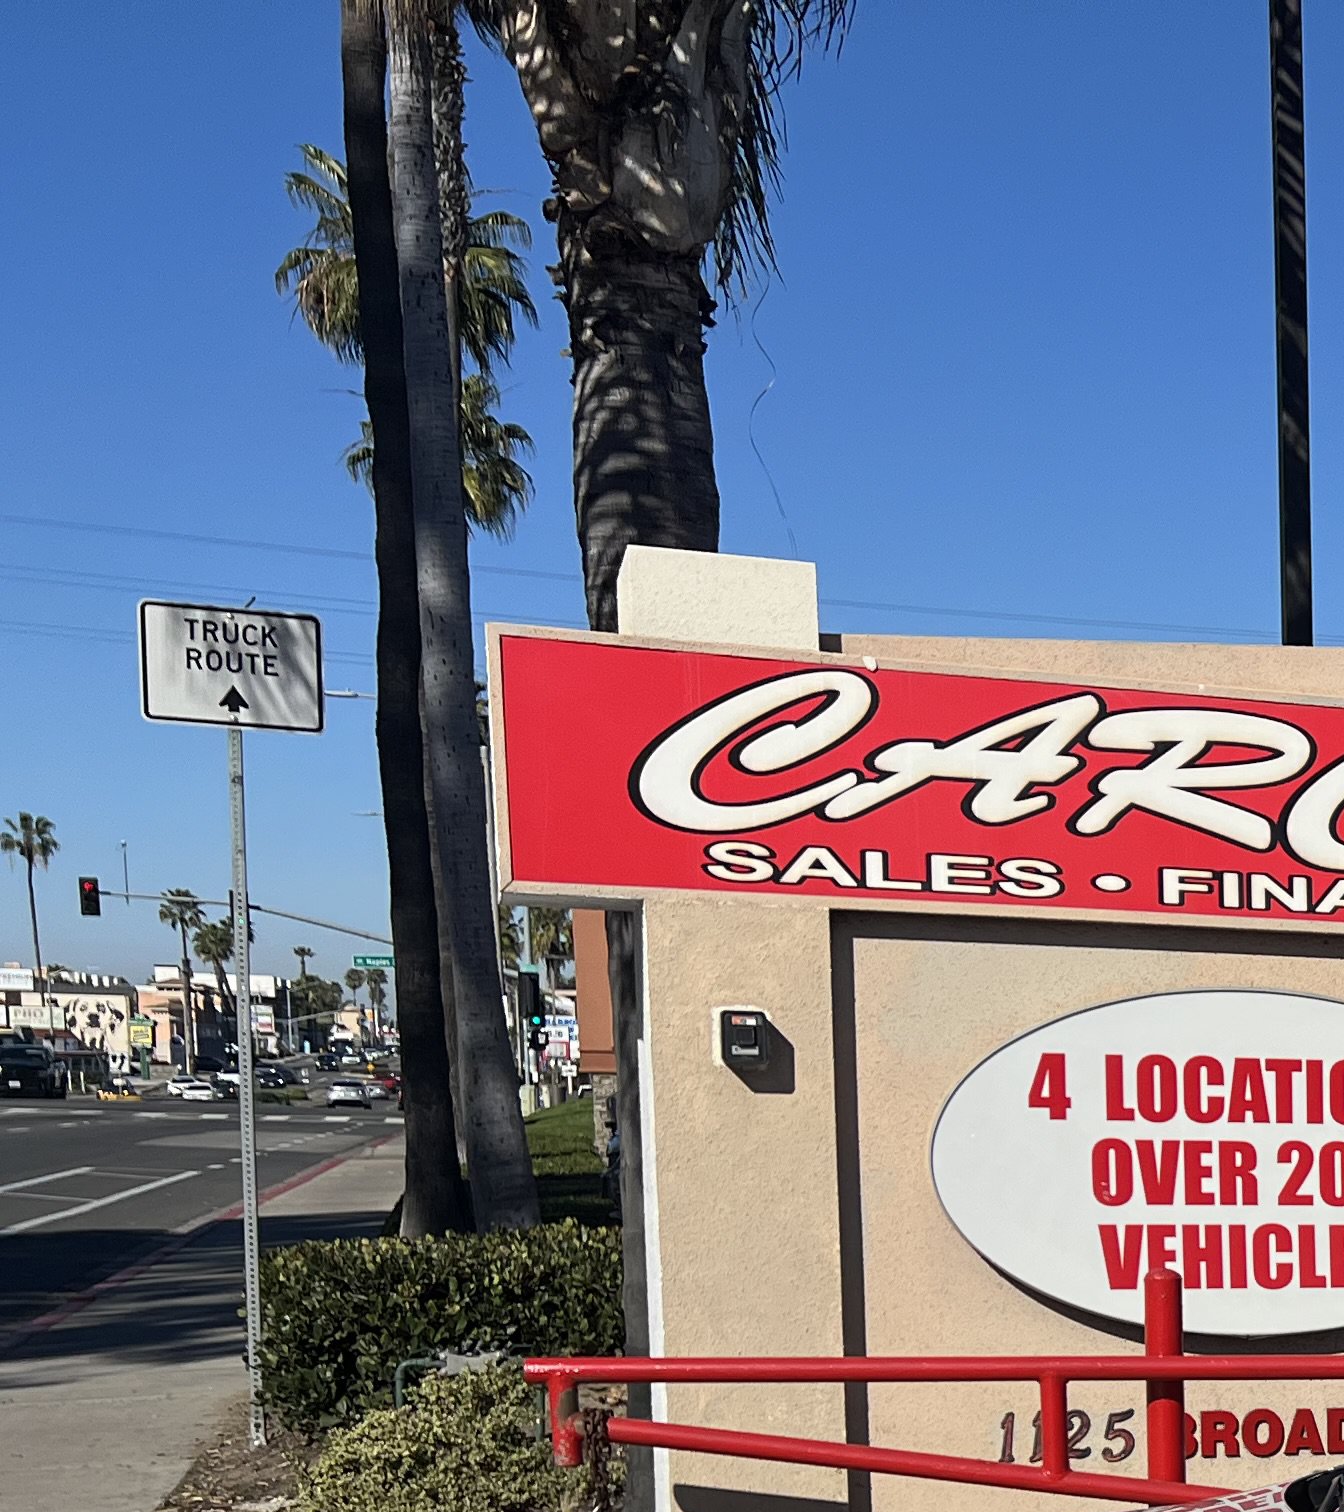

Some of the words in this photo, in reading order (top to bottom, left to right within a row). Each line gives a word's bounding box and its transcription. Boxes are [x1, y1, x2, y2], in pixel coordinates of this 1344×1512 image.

[184, 617, 279, 649] TRUCK
[185, 647, 280, 677] ROUTE
[701, 839, 1066, 898] SALES
[1028, 1052, 1072, 1121] 4
[1091, 1137, 1259, 1207] OVER
